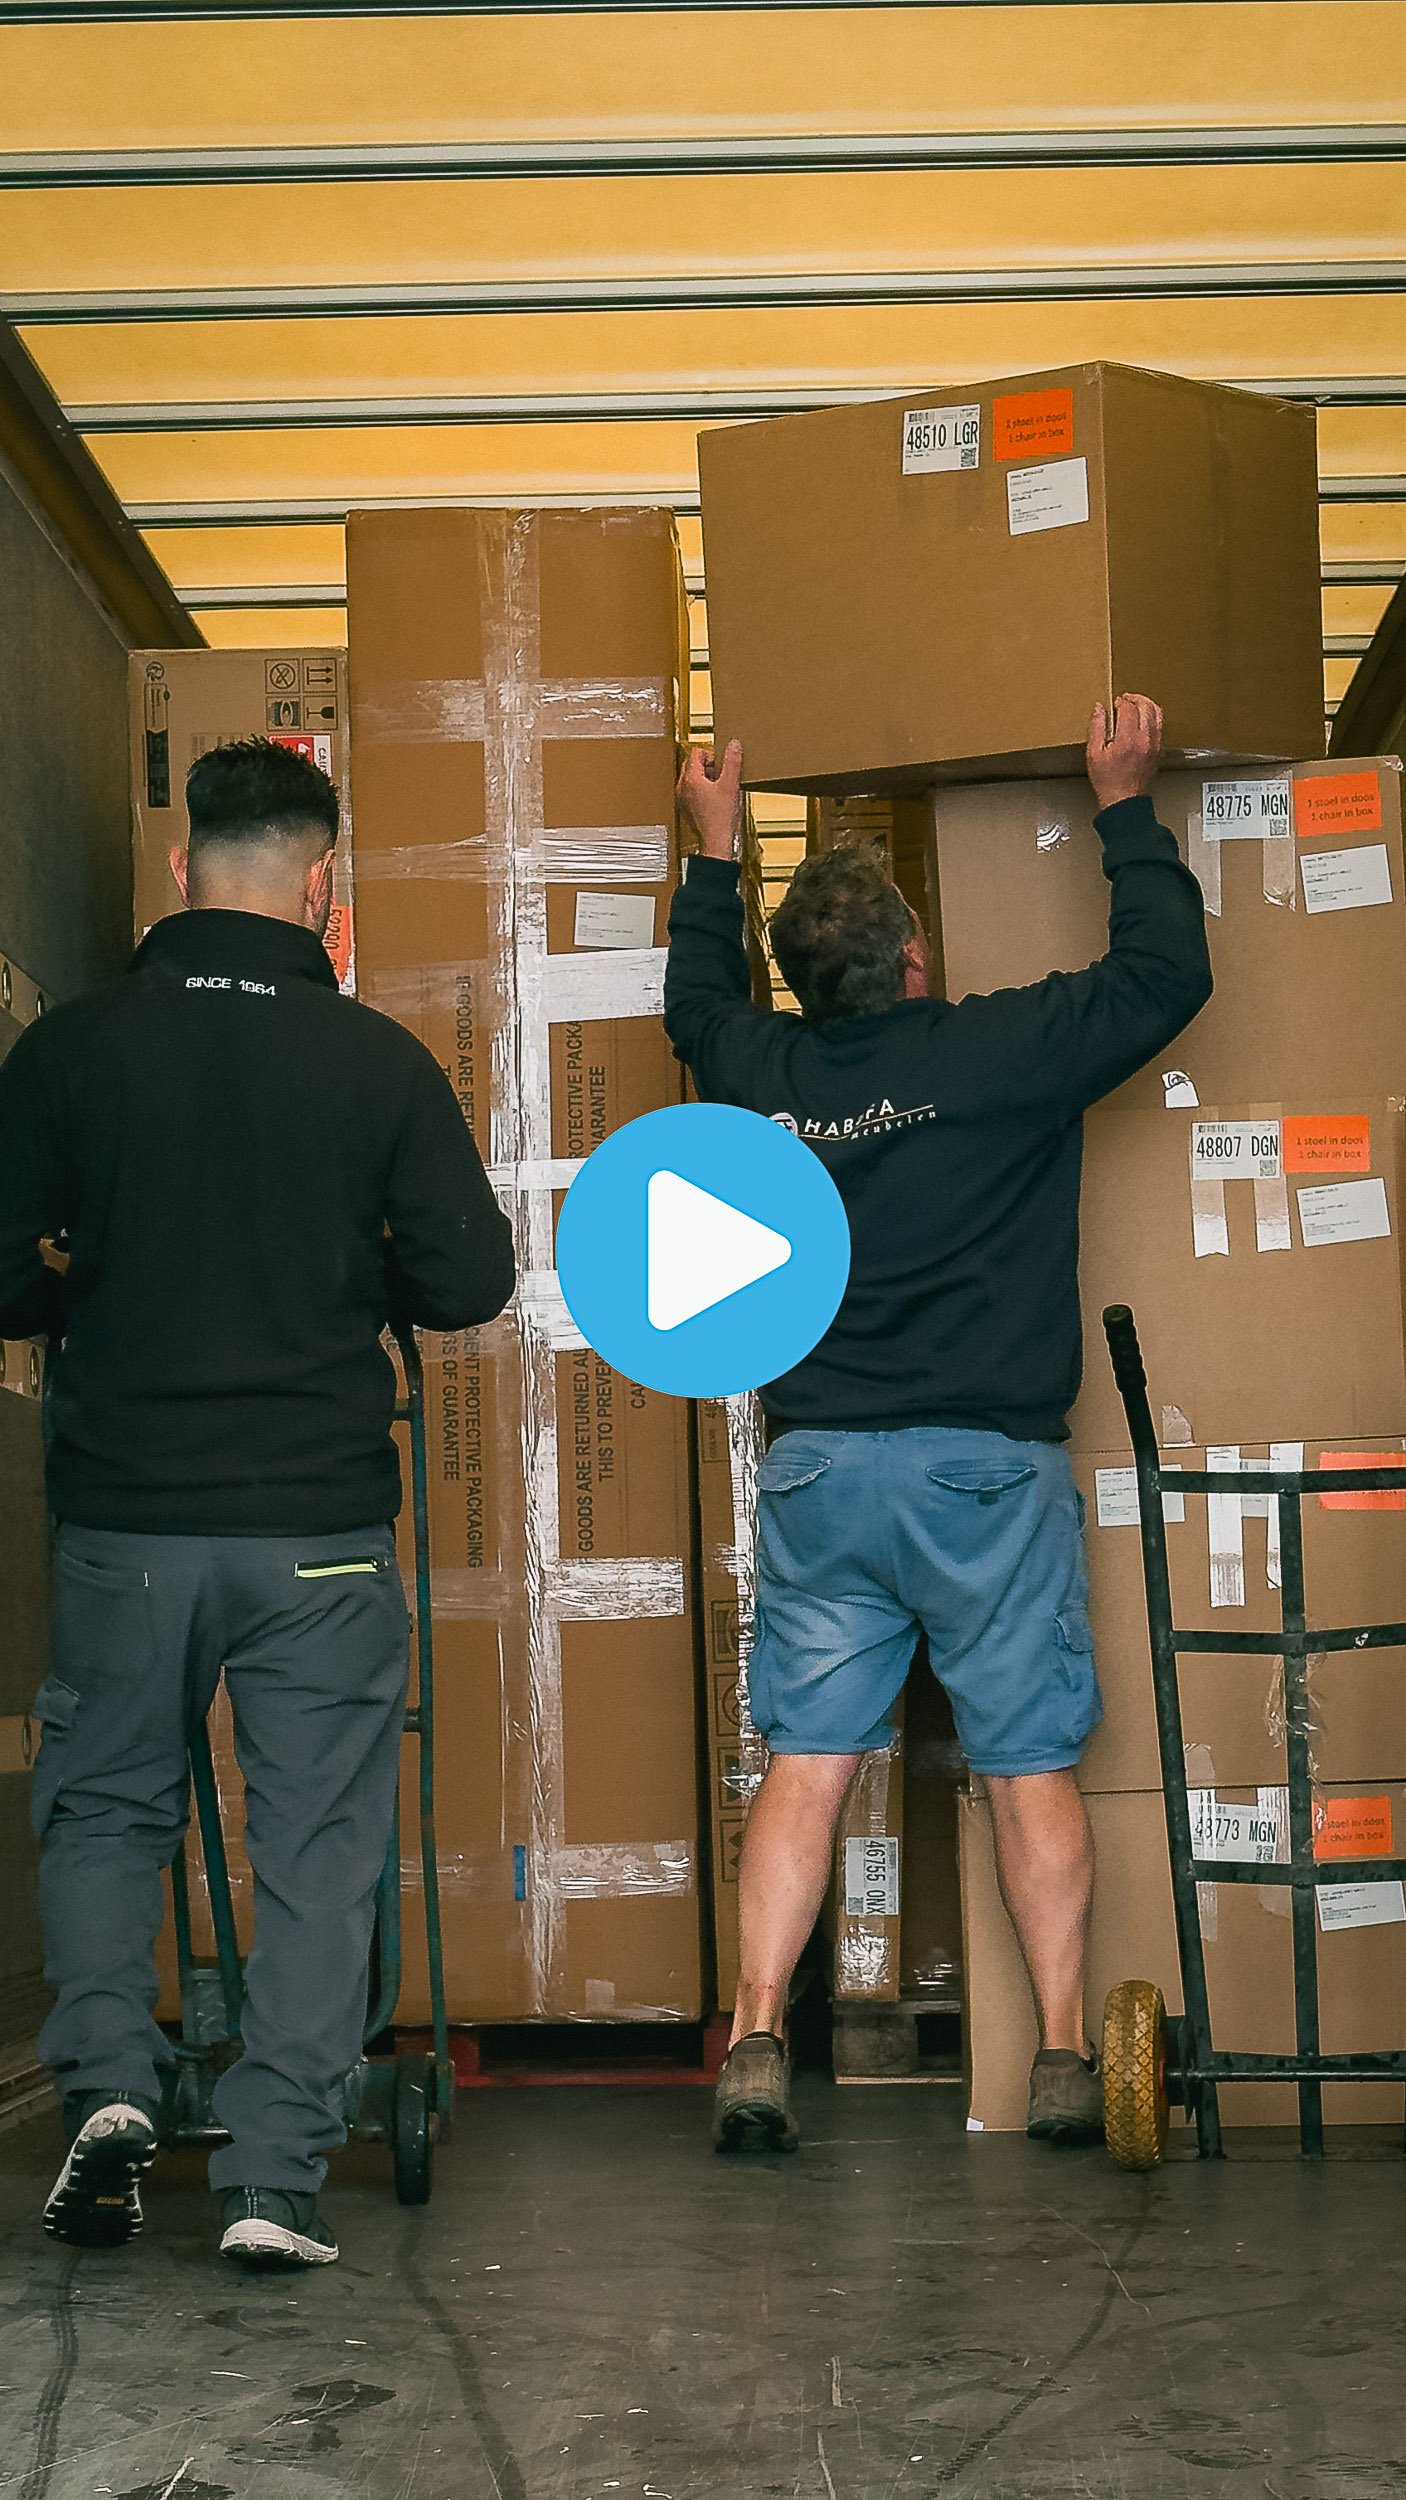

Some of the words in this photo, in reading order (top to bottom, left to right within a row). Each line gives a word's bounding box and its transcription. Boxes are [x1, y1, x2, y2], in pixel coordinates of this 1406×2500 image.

[907, 424, 947, 451] 48510
[954, 420, 978, 446] LGR
[1206, 794, 1252, 818] 48775
[1260, 793, 1288, 816] MGN
[1319, 810, 1342, 821] chair
[1355, 807, 1374, 817] box
[456, 993, 474, 1051] GOODS
[565, 1020, 583, 1070] PACKA
[457, 1054, 474, 1087] ARE
[566, 1074, 584, 1159] ROTECTIVE
[588, 1066, 606, 1151] UARANTEE
[1196, 1136, 1242, 1158] 48807
[1251, 1134, 1279, 1157] DGN
[1304, 1135, 1327, 1146] stoel
[1340, 1135, 1364, 1145] doos
[1306, 1149, 1330, 1159] chair
[1343, 1149, 1362, 1158] box
[464, 1327, 480, 1371] CIENT
[572, 1349, 590, 1368] AL
[442, 1359, 458, 1380] OF
[595, 1353, 613, 1418] PREVEN
[464, 1375, 482, 1473] PROTECTIVE
[573, 1372, 591, 1456] RETURNED
[442, 1384, 460, 1482] GUARANTEE
[597, 1422, 613, 1443] TO
[576, 1460, 592, 1493] ARE
[598, 1446, 614, 1482] THIS
[465, 1477, 484, 1569] PACKAGING
[577, 1495, 595, 1552] GOODS
[1248, 1819, 1277, 1843] MGN
[864, 1840, 886, 1881] 46755
